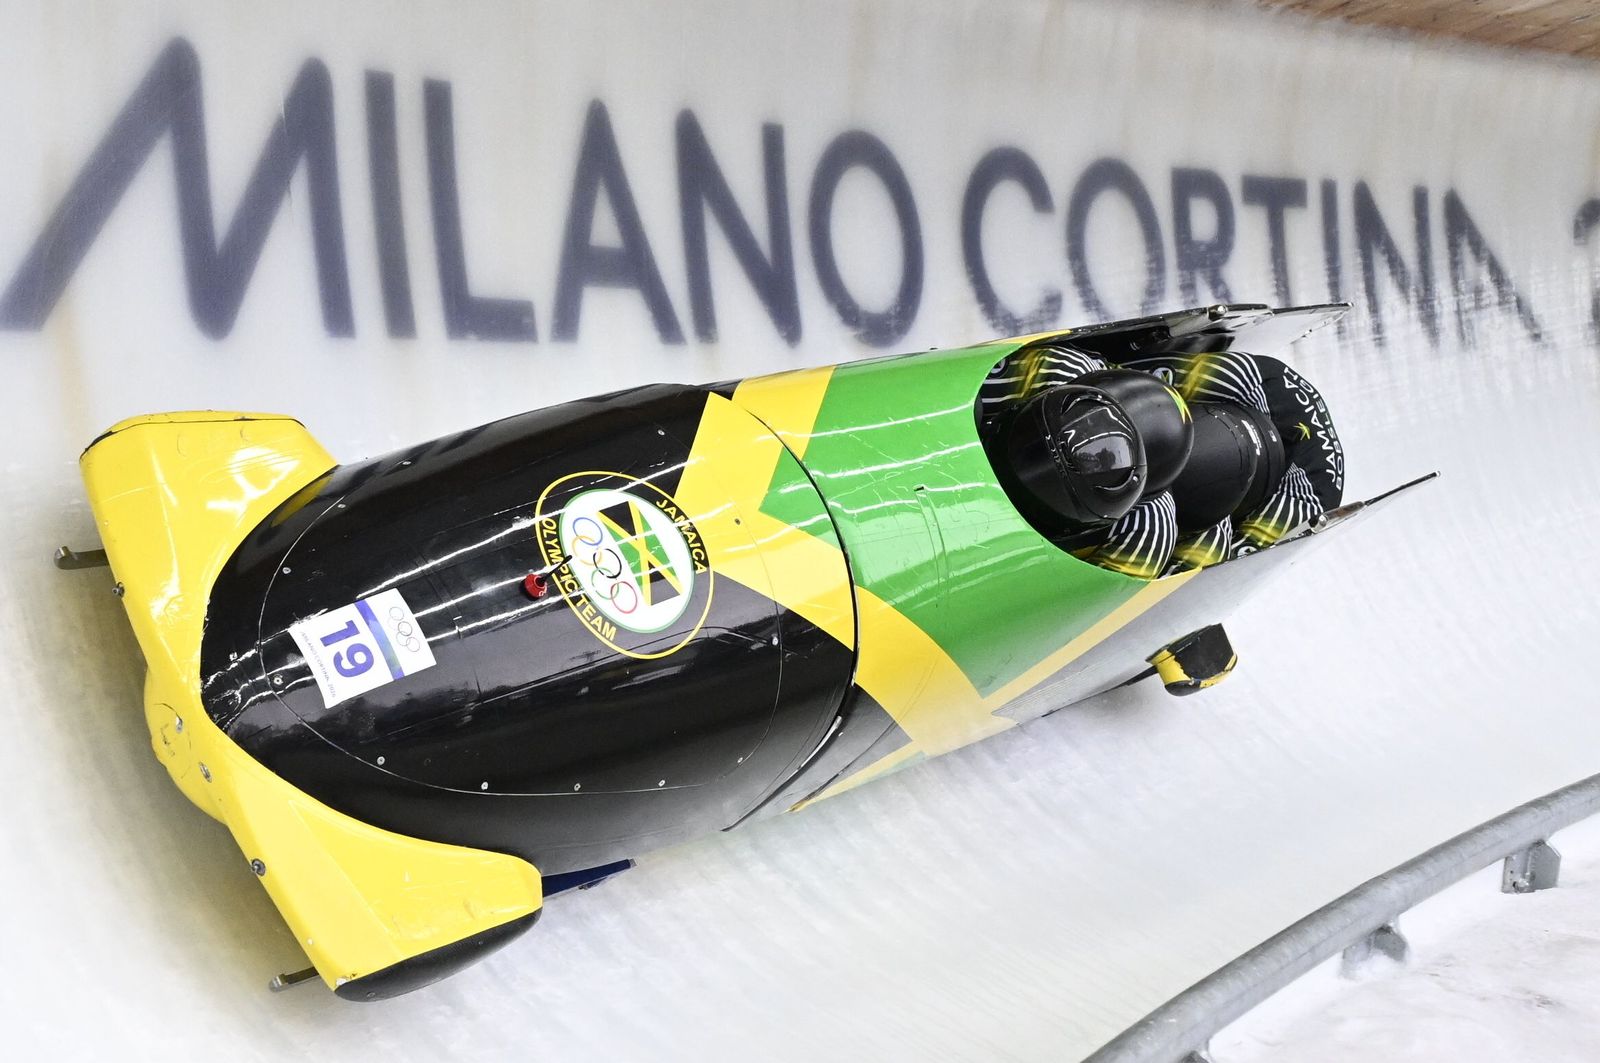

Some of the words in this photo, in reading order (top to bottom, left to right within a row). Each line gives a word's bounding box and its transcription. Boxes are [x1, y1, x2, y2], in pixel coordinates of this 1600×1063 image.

[0, 36, 925, 348] MILANO
[961, 146, 1542, 351] CORTINA
[1283, 375, 1337, 483] JAMAICA
[1284, 367, 1344, 491] BOBSLEIGH
[542, 518, 579, 594] OLYMPIC
[576, 595, 617, 642] TEAM
[656, 499, 708, 575] JAMAICA
[319, 619, 375, 678] 19
